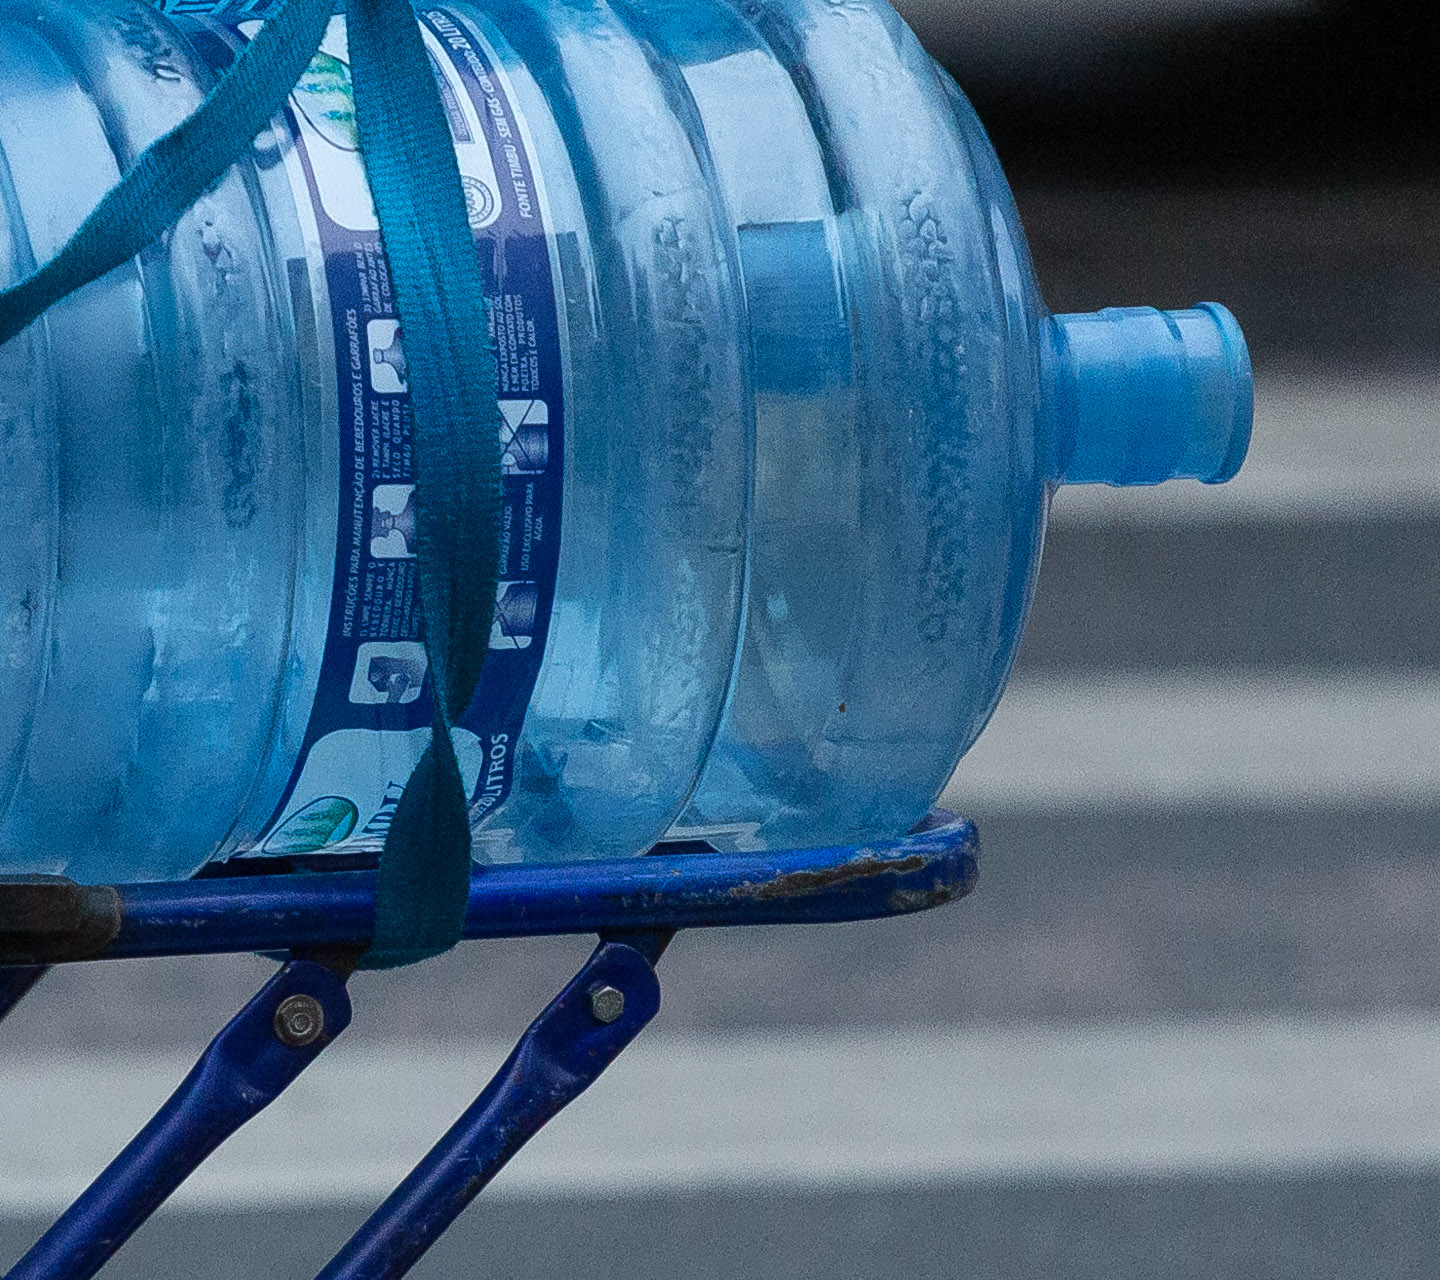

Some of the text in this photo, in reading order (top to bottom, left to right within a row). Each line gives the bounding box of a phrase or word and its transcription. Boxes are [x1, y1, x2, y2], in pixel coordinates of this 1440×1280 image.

[426, 10, 461, 36] LITROS
[448, 37, 471, 49] 20
[496, 117, 512, 138] SEM
[504, 144, 524, 178] TIMBU
[514, 180, 532, 218] FONTE
[494, 296, 502, 309] SOL
[495, 311, 504, 323] AO
[504, 294, 513, 312] COM
[513, 293, 526, 344] PRODUTOS
[344, 308, 362, 369] GARRAFÕES
[505, 313, 516, 350] CONTATO
[351, 382, 365, 452] BEBEDOUROS
[389, 399, 404, 443] QUANDO
[353, 455, 364, 469] DE
[350, 472, 366, 546] MANUTENÇÃO
[520, 482, 534, 570] USO EXCLUSIVO PARA
[350, 548, 360, 573] PARA
[342, 576, 358, 637] INSTRUÇÕES
[369, 575, 384, 637] BEBEDOURO
[481, 733, 507, 796] LITROS
